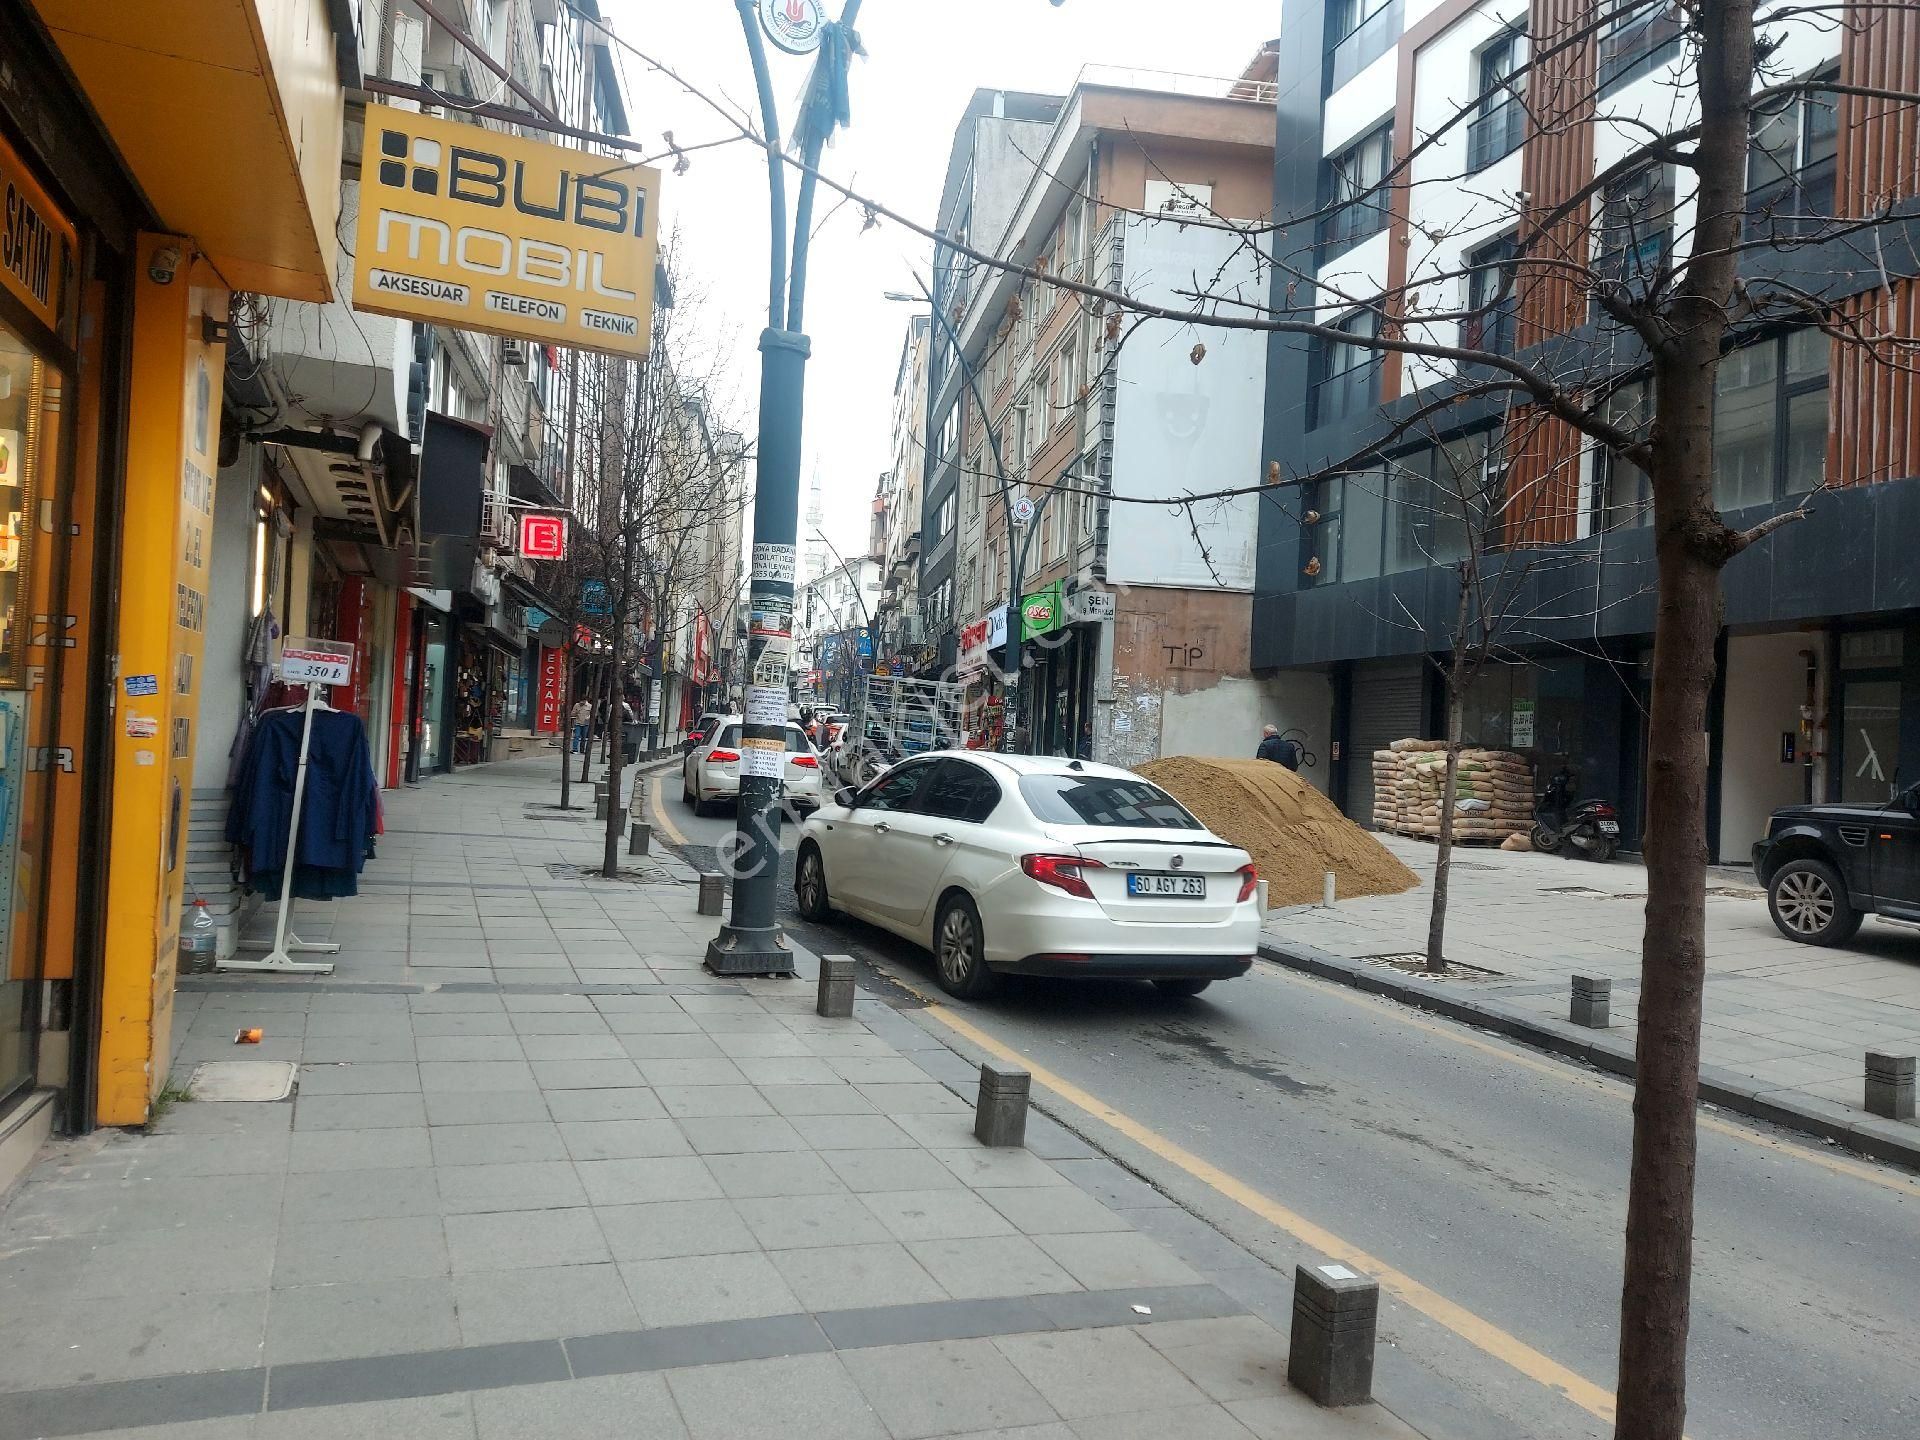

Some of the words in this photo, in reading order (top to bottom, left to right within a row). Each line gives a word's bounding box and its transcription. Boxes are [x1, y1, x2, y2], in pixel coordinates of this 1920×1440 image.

[377, 273, 464, 302] AKSESUAR
[490, 295, 560, 321] TELEFON
[583, 311, 635, 335] TEKNİK
[1088, 595, 1109, 607] ŞEN
[304, 665, 329, 677] 350
[543, 653, 556, 724] ECZANE
[1136, 876, 1151, 892] 60
[1156, 877, 1177, 893] AGY
[1182, 878, 1202, 894] 263
